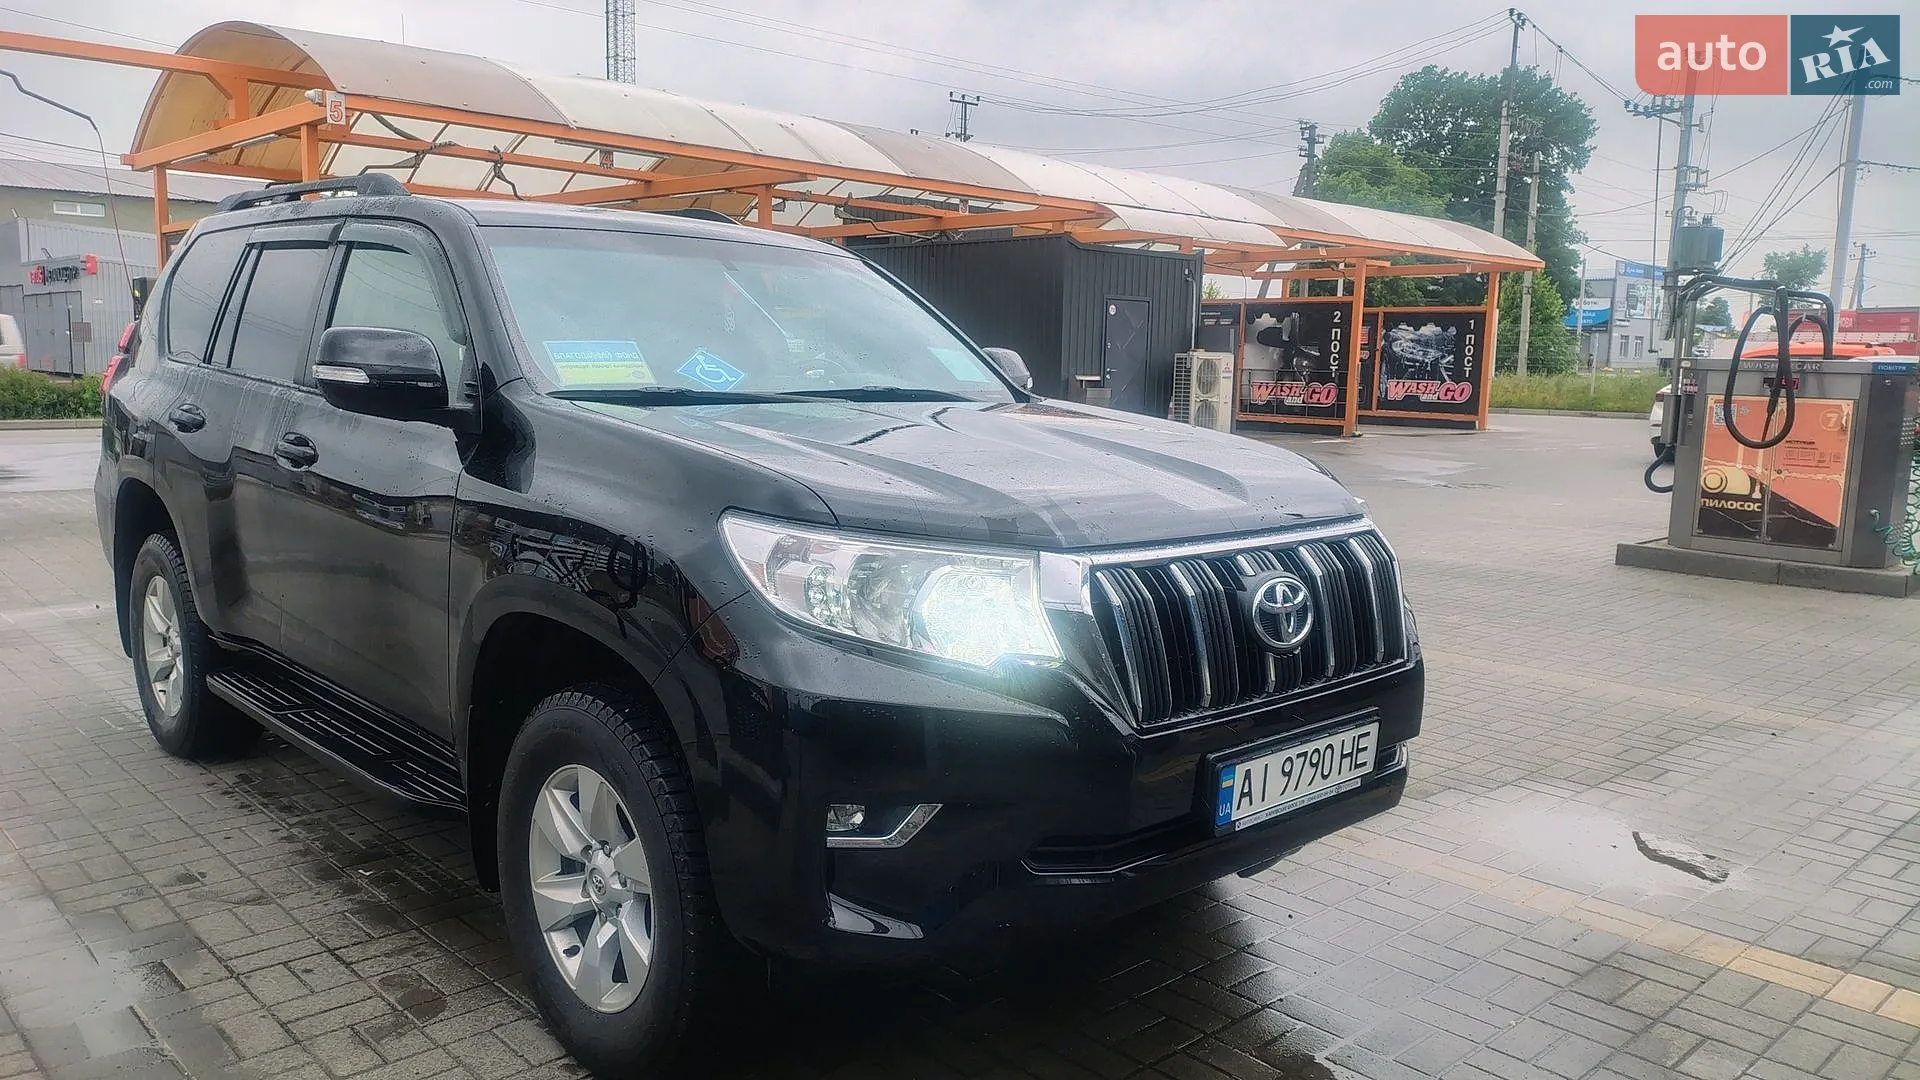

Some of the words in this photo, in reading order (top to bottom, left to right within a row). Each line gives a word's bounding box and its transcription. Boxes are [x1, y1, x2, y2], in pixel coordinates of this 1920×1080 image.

[330, 100, 343, 122] 5
[1333, 310, 1341, 323] 2
[1468, 319, 1475, 330] 1
[1330, 328, 1341, 378] ПОСТ
[1464, 334, 1475, 378] ПОСТ
[1252, 382, 1304, 403] WASH
[1304, 383, 1337, 404] GO
[1388, 381, 1438, 399] WASH
[1439, 382, 1472, 401] GO
[1824, 412, 1839, 427] 7
[1700, 498, 1762, 512] ПИЛОСОС
[1236, 763, 1269, 811] AI
[1279, 743, 1335, 797] 9790
[1338, 731, 1371, 776] HE
[1219, 802, 1231, 817] UA
